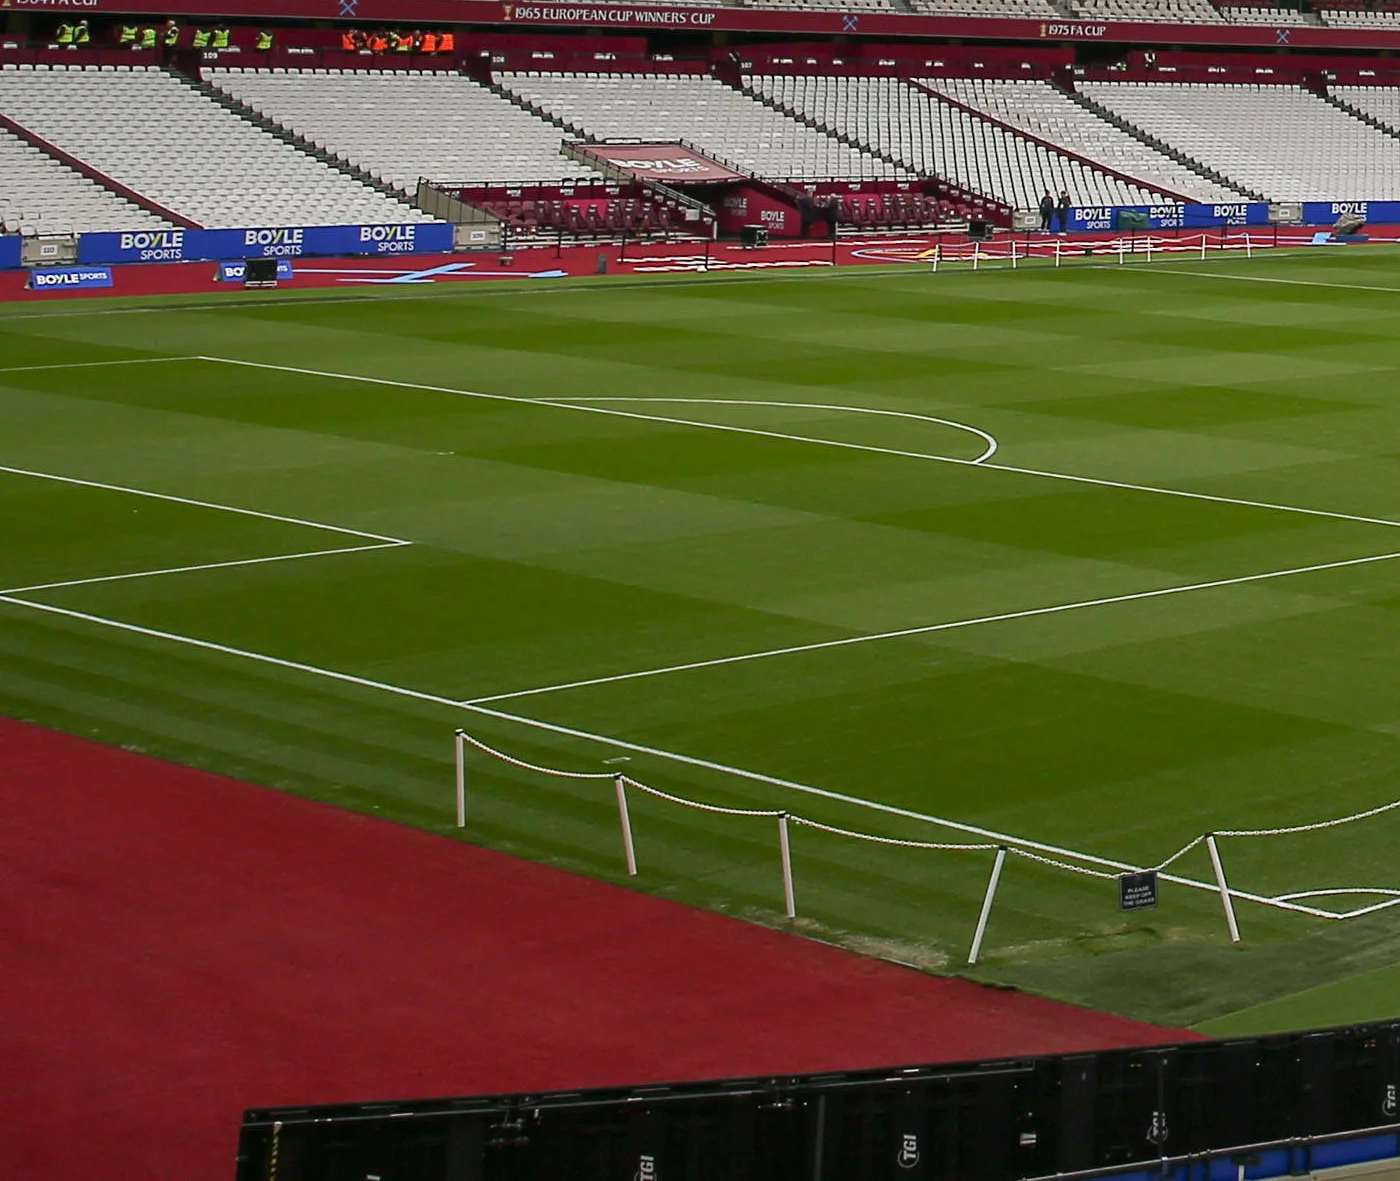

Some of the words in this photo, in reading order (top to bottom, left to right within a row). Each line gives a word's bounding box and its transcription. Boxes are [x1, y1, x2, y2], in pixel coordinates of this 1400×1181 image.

[515, 7, 540, 19] 1965
[543, 9, 607, 21] EUROPEAN
[608, 11, 633, 22] CUP
[634, 11, 689, 23] WINNERS'
[690, 13, 715, 24] CUP
[1048, 25, 1069, 35] 1975
[1070, 25, 1084, 36] FA
[1084, 26, 1106, 37] CUP
[1075, 207, 1112, 221] BOYLE
[1150, 207, 1184, 219] BOYLE
[1214, 205, 1248, 217] BOYLE
[1332, 203, 1368, 214] BOYLE
[760, 211, 784, 221] BOYLE
[1086, 220, 1111, 229] SPORTS
[245, 229, 304, 245] BOYLE
[360, 225, 415, 242] BOYLE
[120, 233, 184, 249] BOYLE
[378, 241, 414, 251] SPORTS
[140, 249, 182, 259] SPORTS
[264, 245, 302, 255] SPORTS
[36, 273, 79, 285] BOYLE
[80, 272, 106, 281] SPORTS
[904, 1134, 916, 1161] TGI
